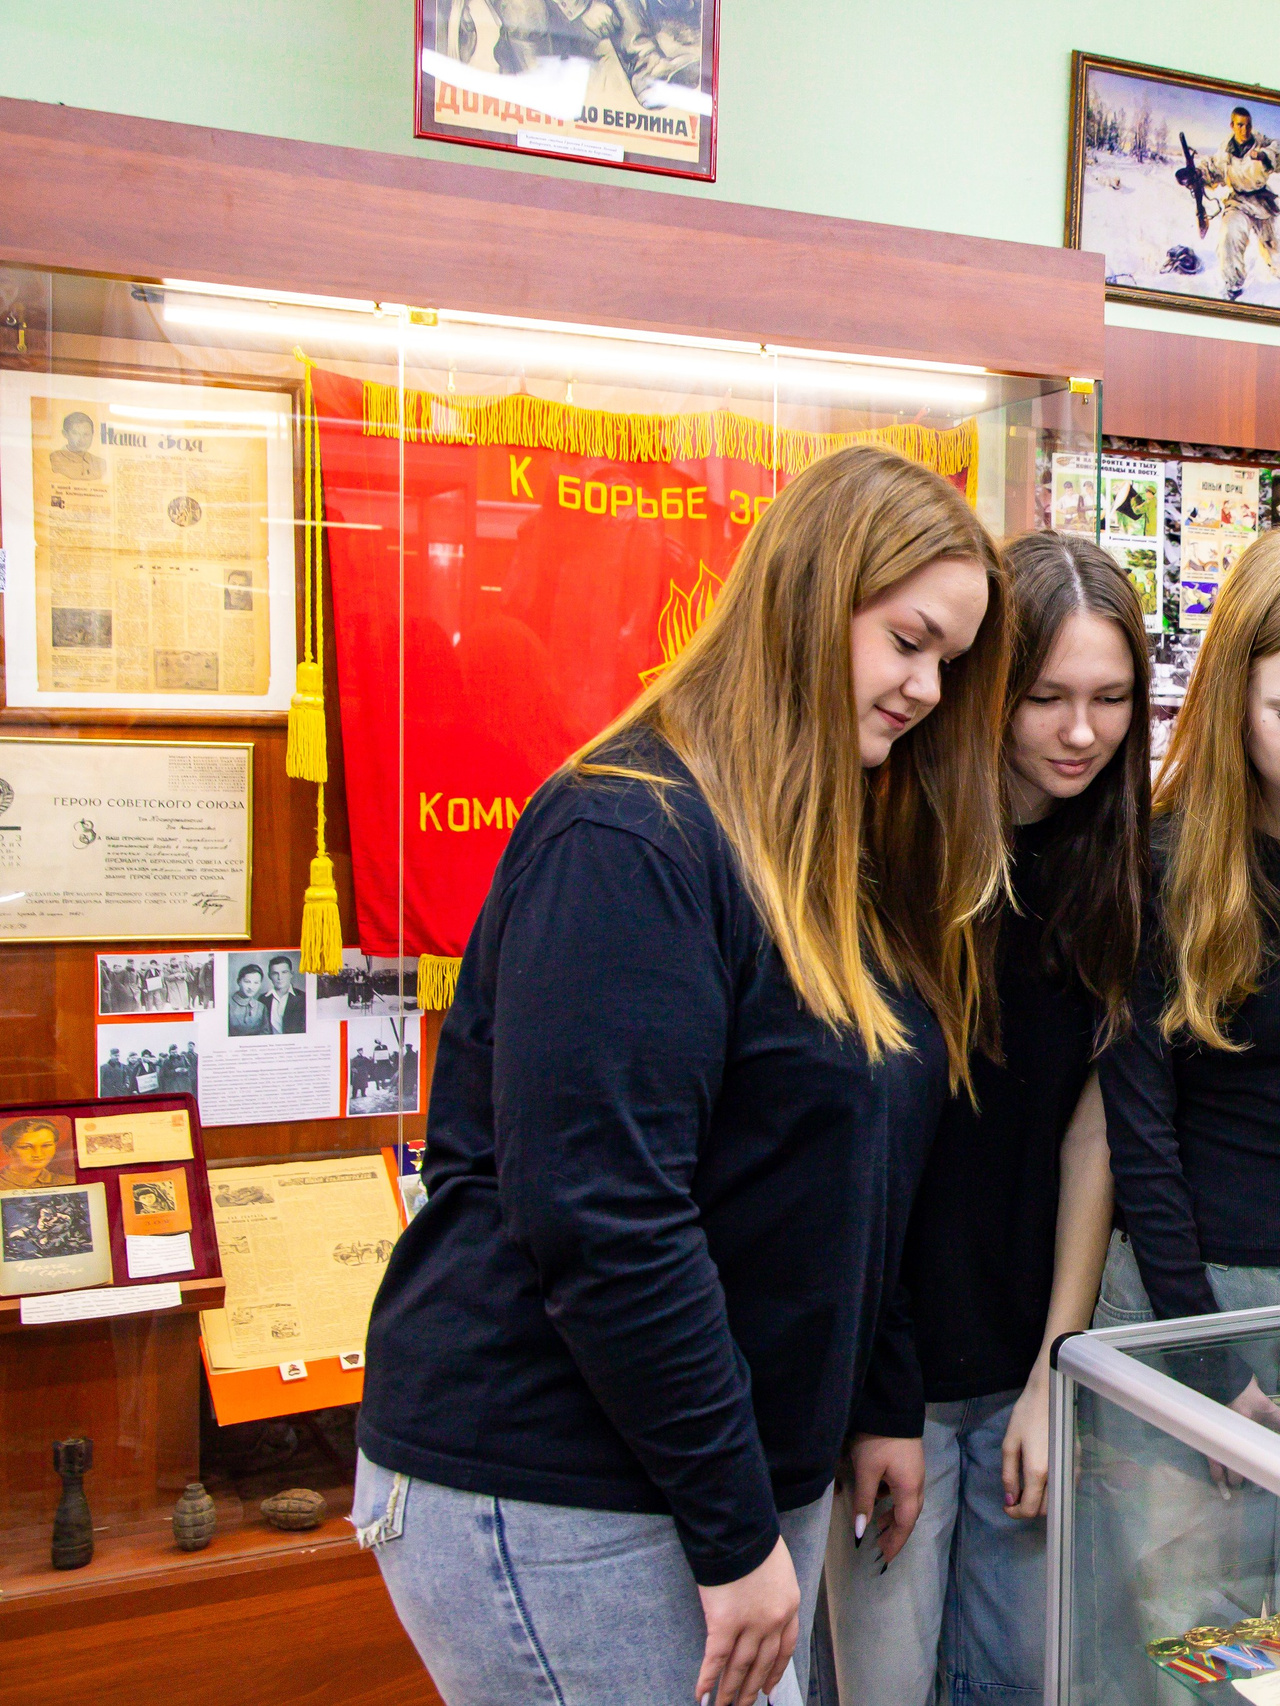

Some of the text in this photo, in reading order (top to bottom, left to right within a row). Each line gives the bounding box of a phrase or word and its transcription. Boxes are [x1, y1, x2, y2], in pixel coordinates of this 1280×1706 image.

[603, 107, 700, 140] БЕРЛИНА!
[509, 454, 534, 499] К
[558, 474, 708, 521] БОРЬБЕ
[53, 796, 245, 810] ГЕРОЮ СОВЕТСКОГО СОЮЗА
